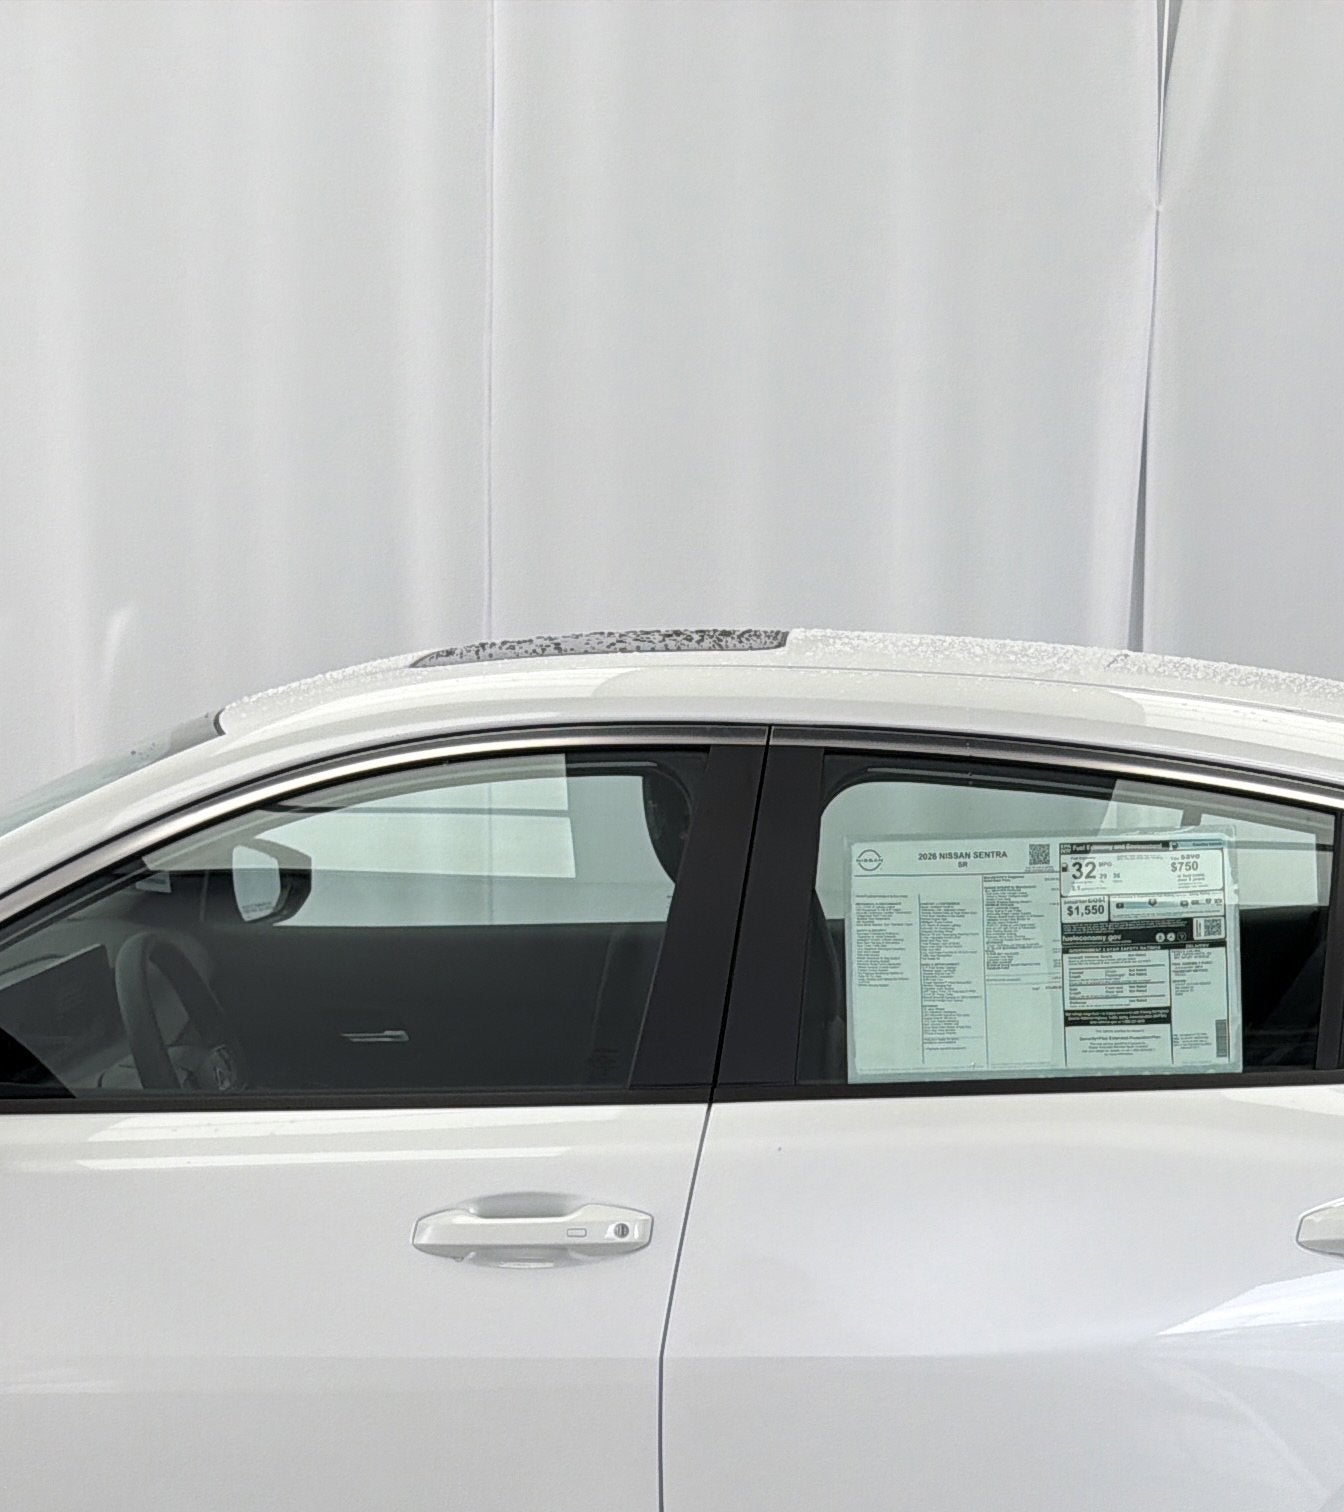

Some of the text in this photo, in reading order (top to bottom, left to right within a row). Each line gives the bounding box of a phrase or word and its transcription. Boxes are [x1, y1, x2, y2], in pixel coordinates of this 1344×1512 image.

[939, 851, 971, 860] NISSAN
[973, 850, 1008, 859] SENTRA
[1071, 861, 1096, 880] 32
[1170, 860, 1199, 872] $750
[1067, 904, 1105, 917] $1,550
